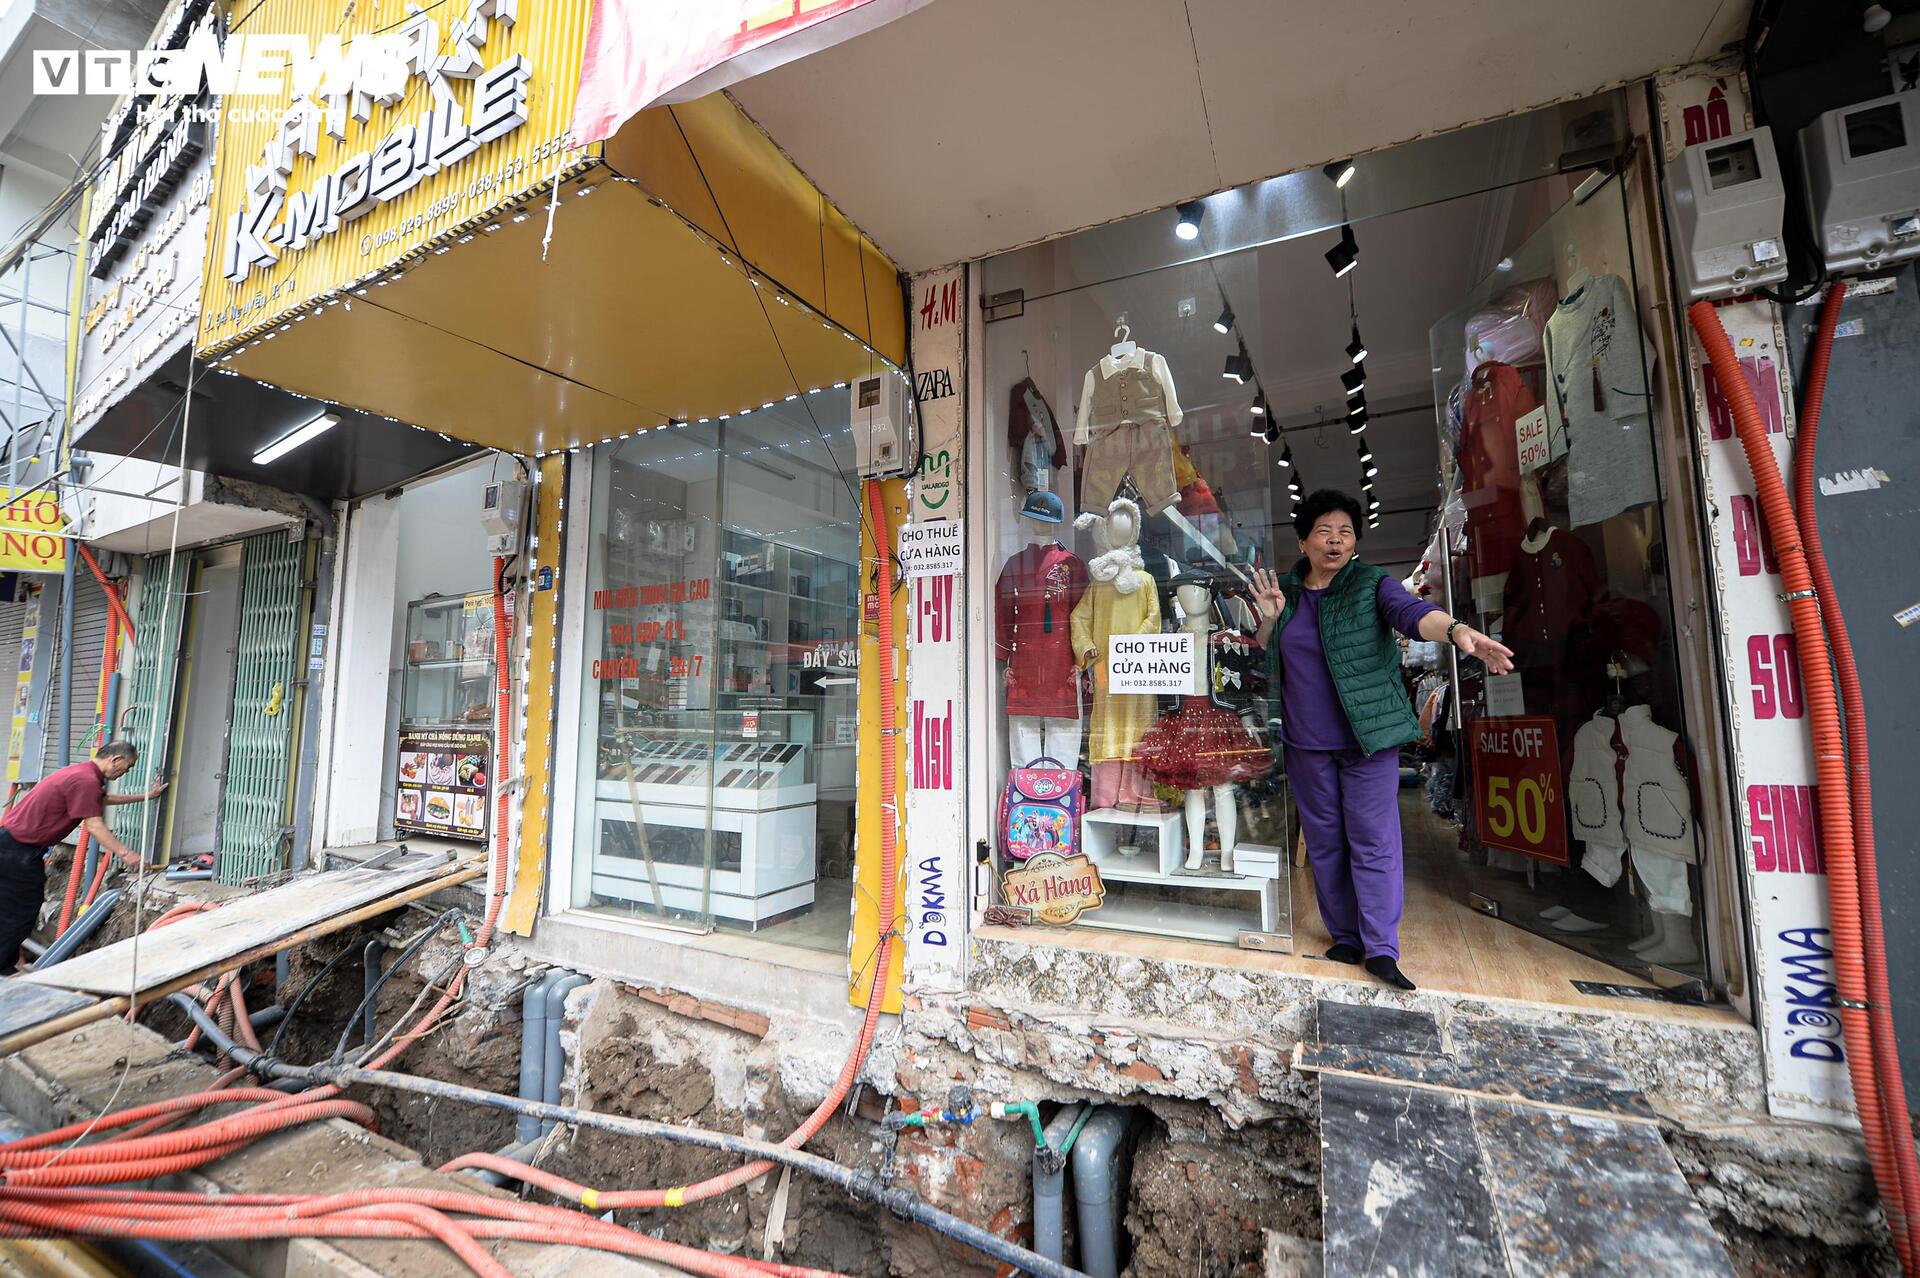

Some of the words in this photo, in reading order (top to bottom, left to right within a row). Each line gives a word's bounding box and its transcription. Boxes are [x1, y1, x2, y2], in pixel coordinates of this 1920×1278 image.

[223, 52, 533, 284] K-MOBILE
[920, 279, 957, 331] H&M
[918, 366, 956, 402] ZARA
[1520, 418, 1543, 443] SALE
[1520, 441, 1546, 465] 50%
[902, 529, 923, 543] CHO
[926, 523, 959, 540] THUÊ
[900, 546, 922, 562] CỬA
[925, 544, 961, 559] HÀNG
[914, 562, 953, 571] 032.8585.317
[689, 578, 710, 600] CAO
[1115, 642, 1145, 654] CHO
[1149, 638, 1188, 654] THUÊ
[1112, 658, 1144, 674] CỬA
[1148, 658, 1191, 674] HÀNG
[1480, 732, 1508, 754] SALE
[1512, 727, 1543, 759] OFF
[1487, 772, 1554, 844] 50%
[1014, 879, 1040, 906] Xả
[1043, 874, 1093, 904] Hàng
